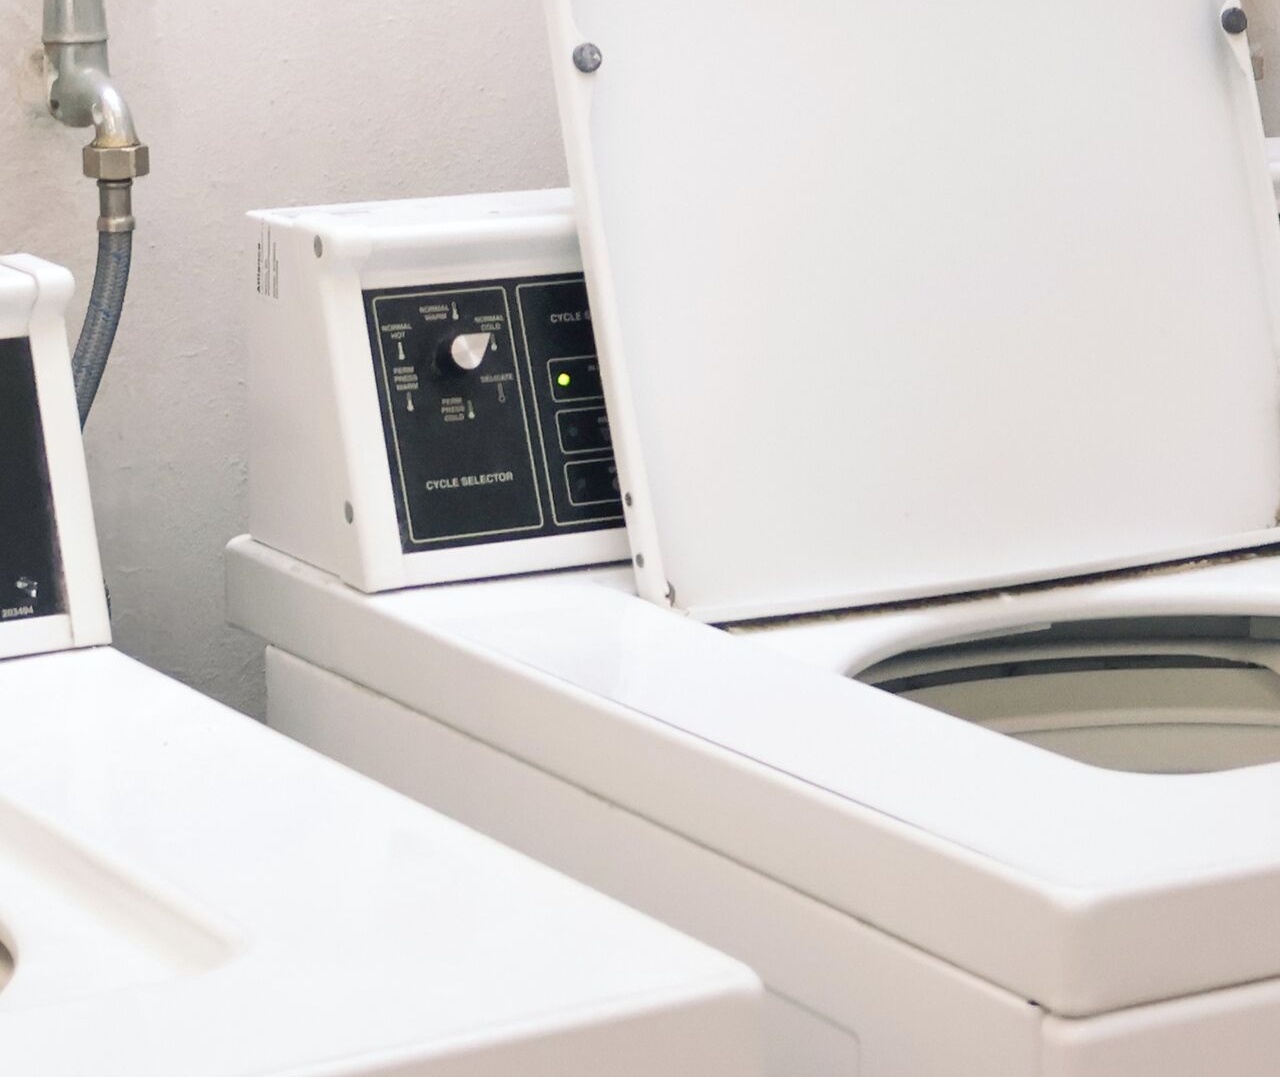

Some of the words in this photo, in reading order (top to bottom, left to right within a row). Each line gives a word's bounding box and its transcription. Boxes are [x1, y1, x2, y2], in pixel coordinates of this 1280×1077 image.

[419, 304, 450, 313] NORMAL
[474, 314, 504, 322] NORMAL
[550, 312, 581, 323] CYCLE
[381, 324, 412, 332] NORMAL
[390, 332, 406, 340] HOT
[426, 476, 459, 490] CYCLE
[460, 471, 514, 487] SELECTOR
